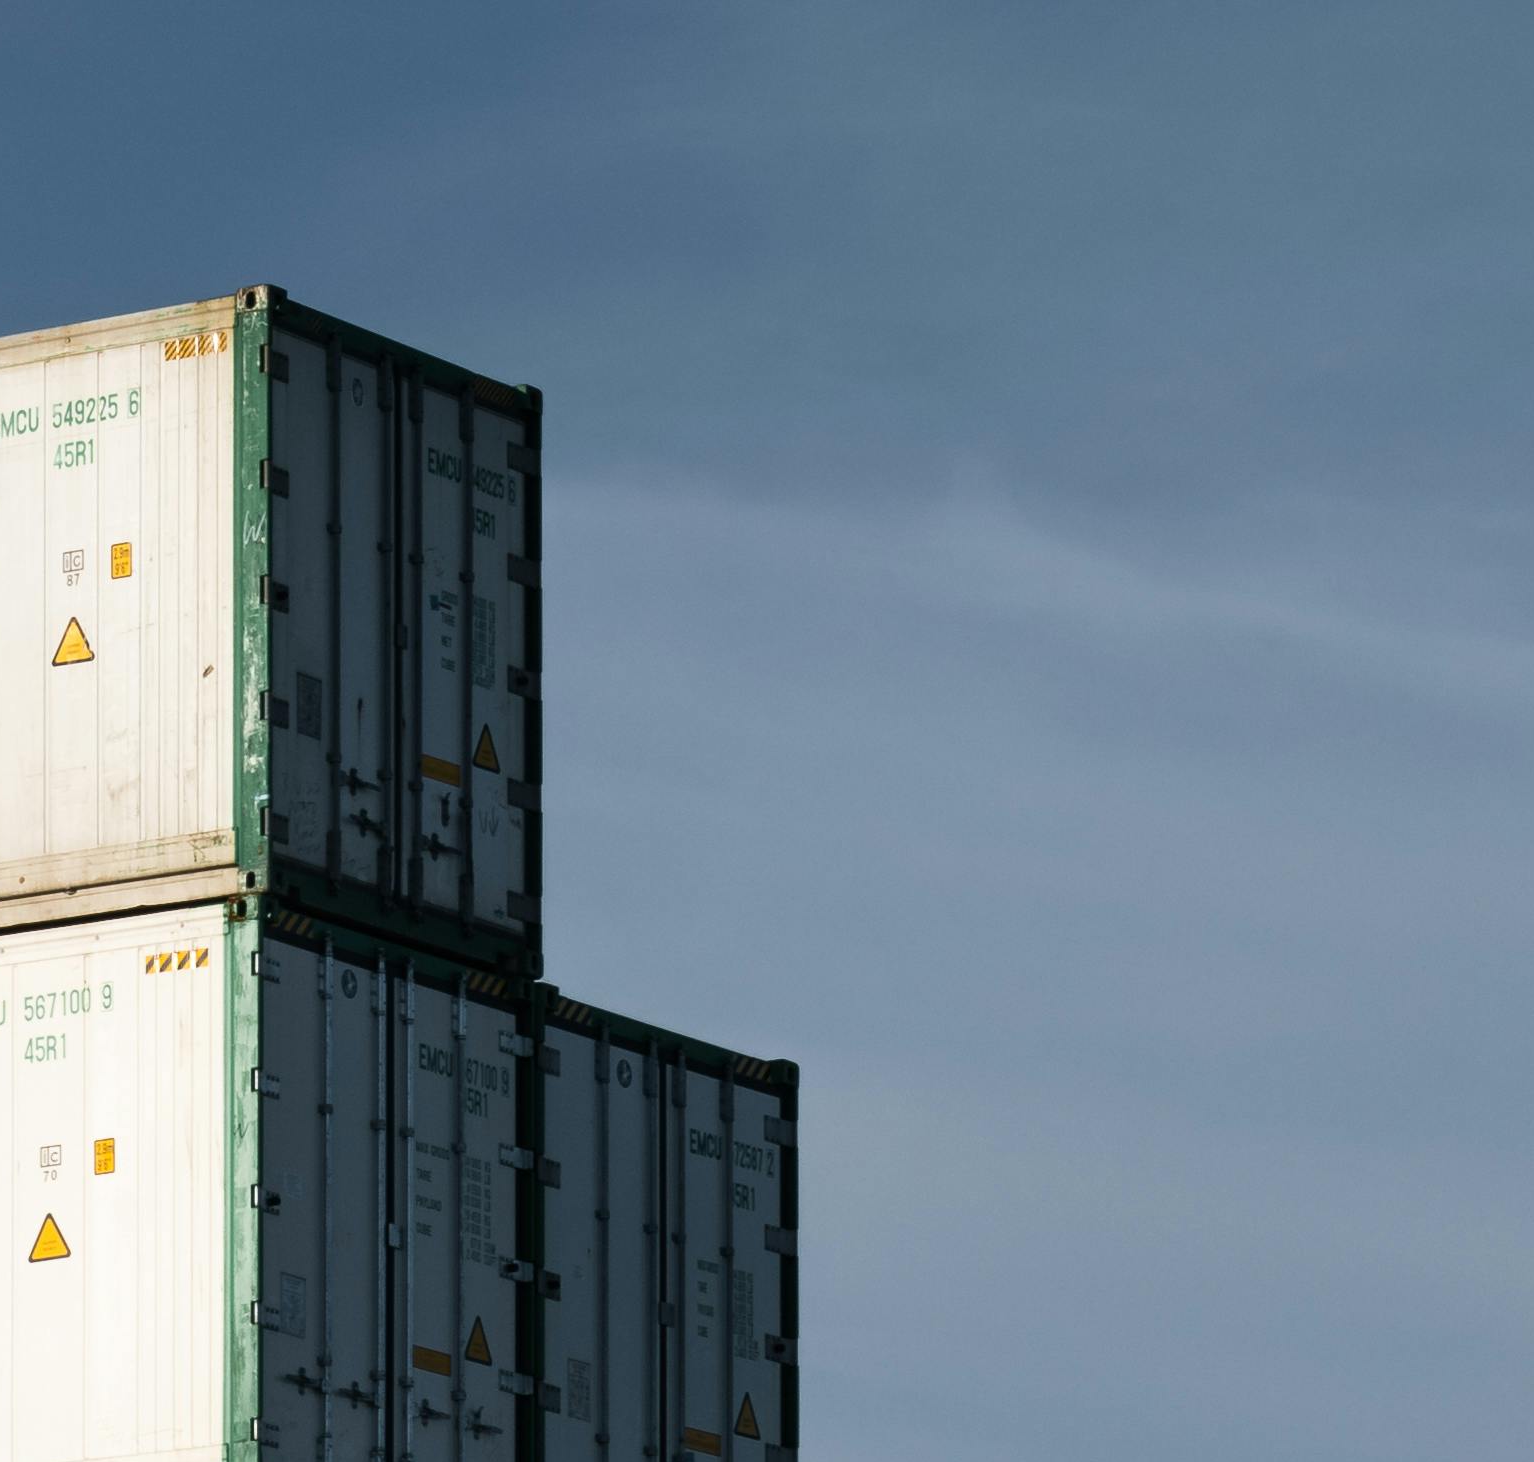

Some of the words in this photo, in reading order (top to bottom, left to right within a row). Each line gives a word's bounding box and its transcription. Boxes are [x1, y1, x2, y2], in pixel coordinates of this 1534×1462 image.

[52, 397, 118, 428] 549225
[129, 389, 139, 417] 6
[54, 439, 94, 470] 45R1
[66, 574, 80, 586] 87
[24, 988, 91, 1021] 567100
[102, 984, 112, 1009] 9
[24, 1033, 67, 1063] 45R1
[419, 1043, 452, 1078] EMCU
[466, 1057, 497, 1092] 67100
[43, 1171, 57, 1181] 70
